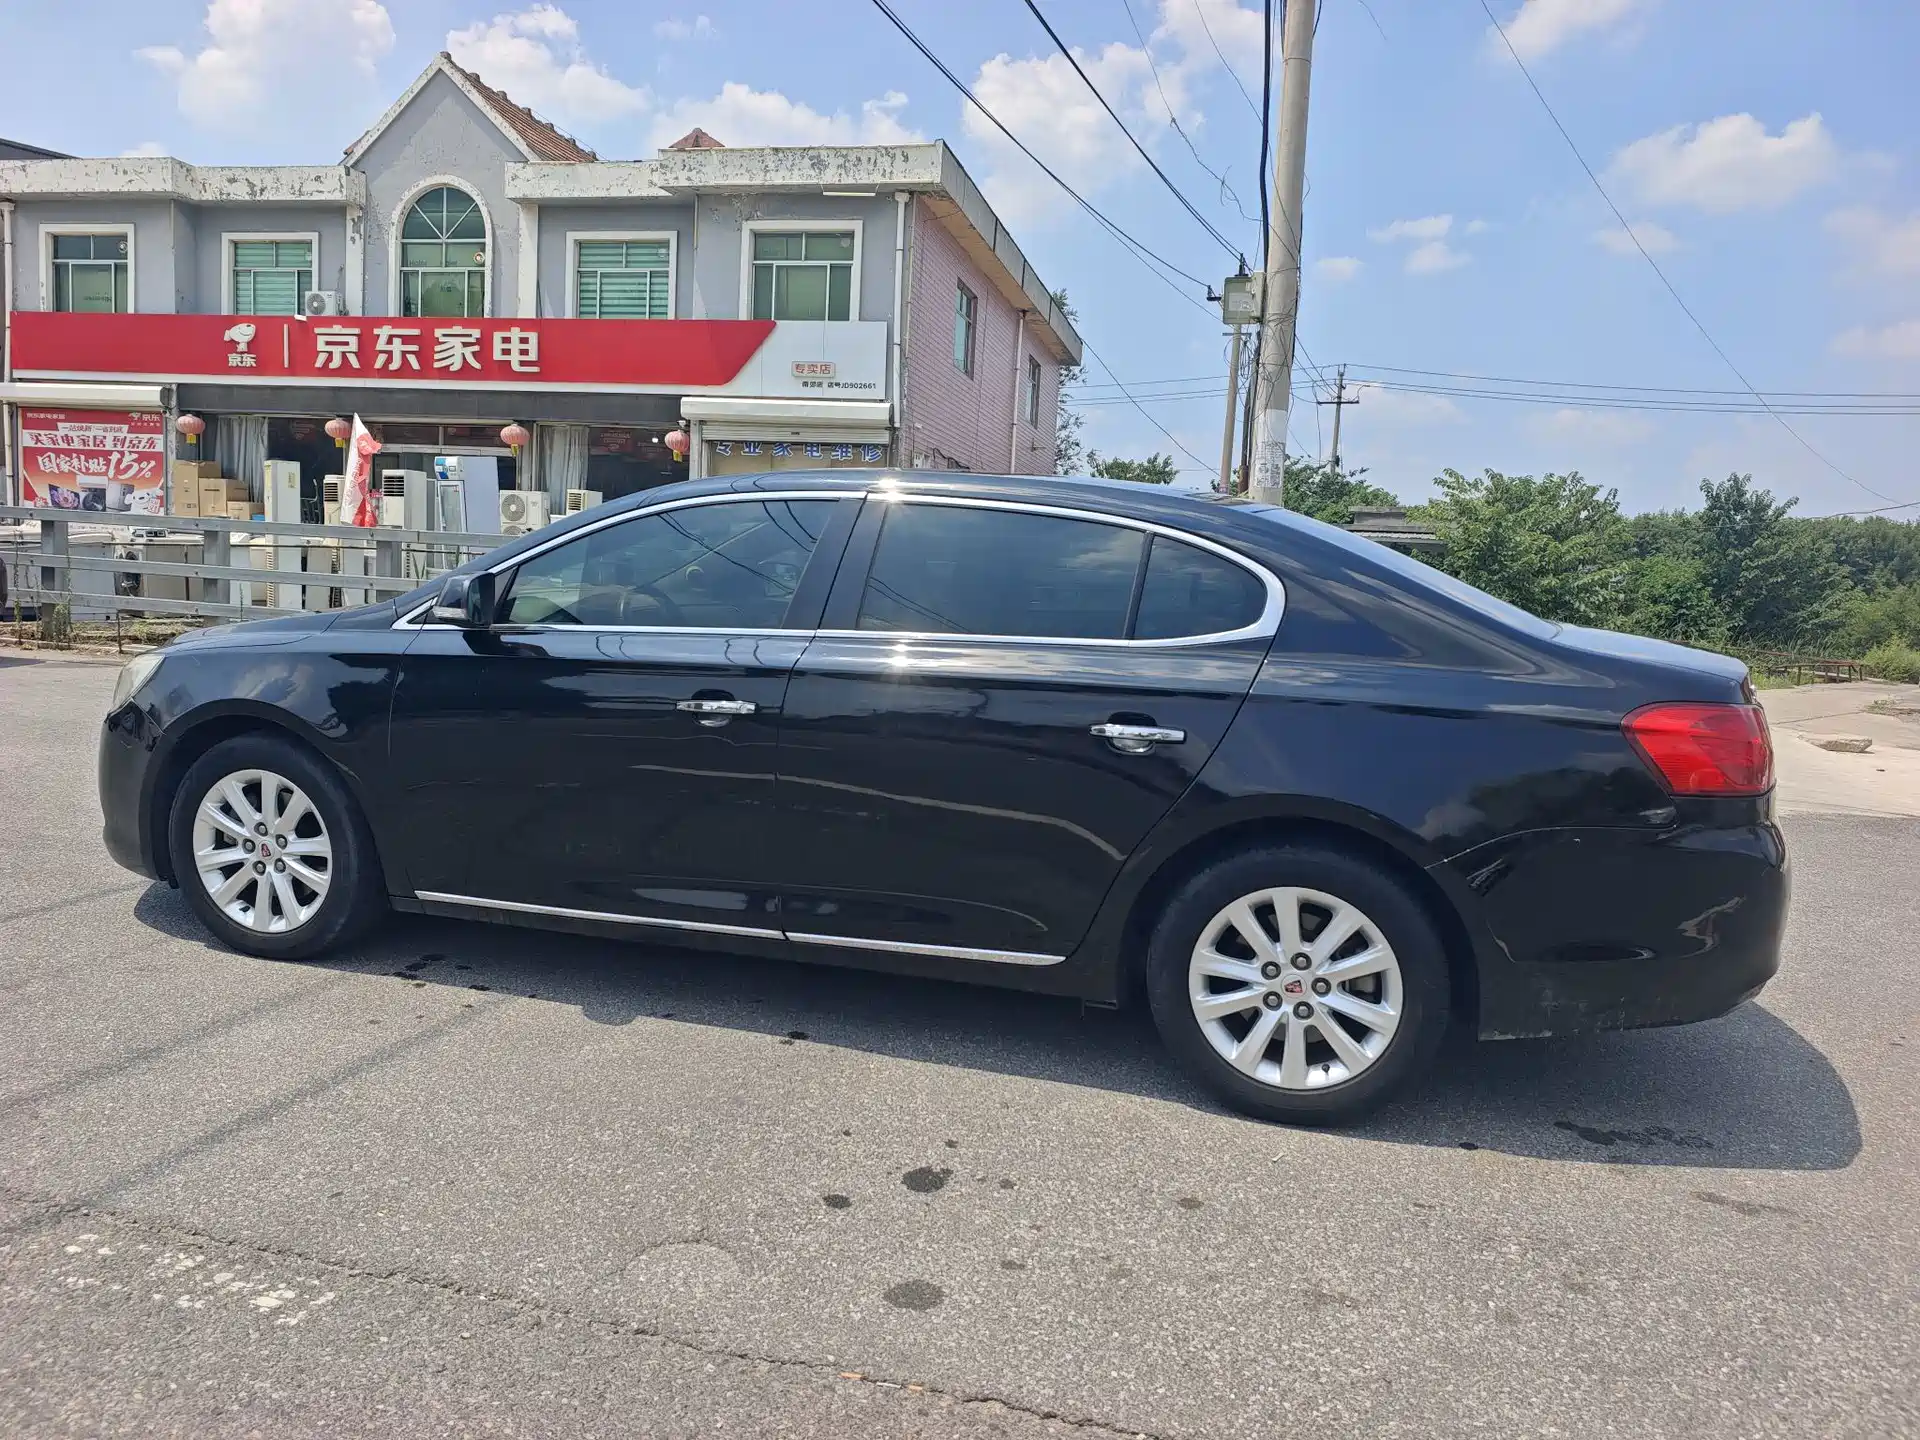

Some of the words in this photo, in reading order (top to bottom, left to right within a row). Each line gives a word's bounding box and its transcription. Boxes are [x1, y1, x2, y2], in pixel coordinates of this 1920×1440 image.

[313, 324, 541, 372] 京东家电
[227, 353, 257, 367] 京东
[794, 363, 832, 375] 专卖店
[28, 432, 107, 449] 买家电家居
[111, 435, 158, 450] 到京东
